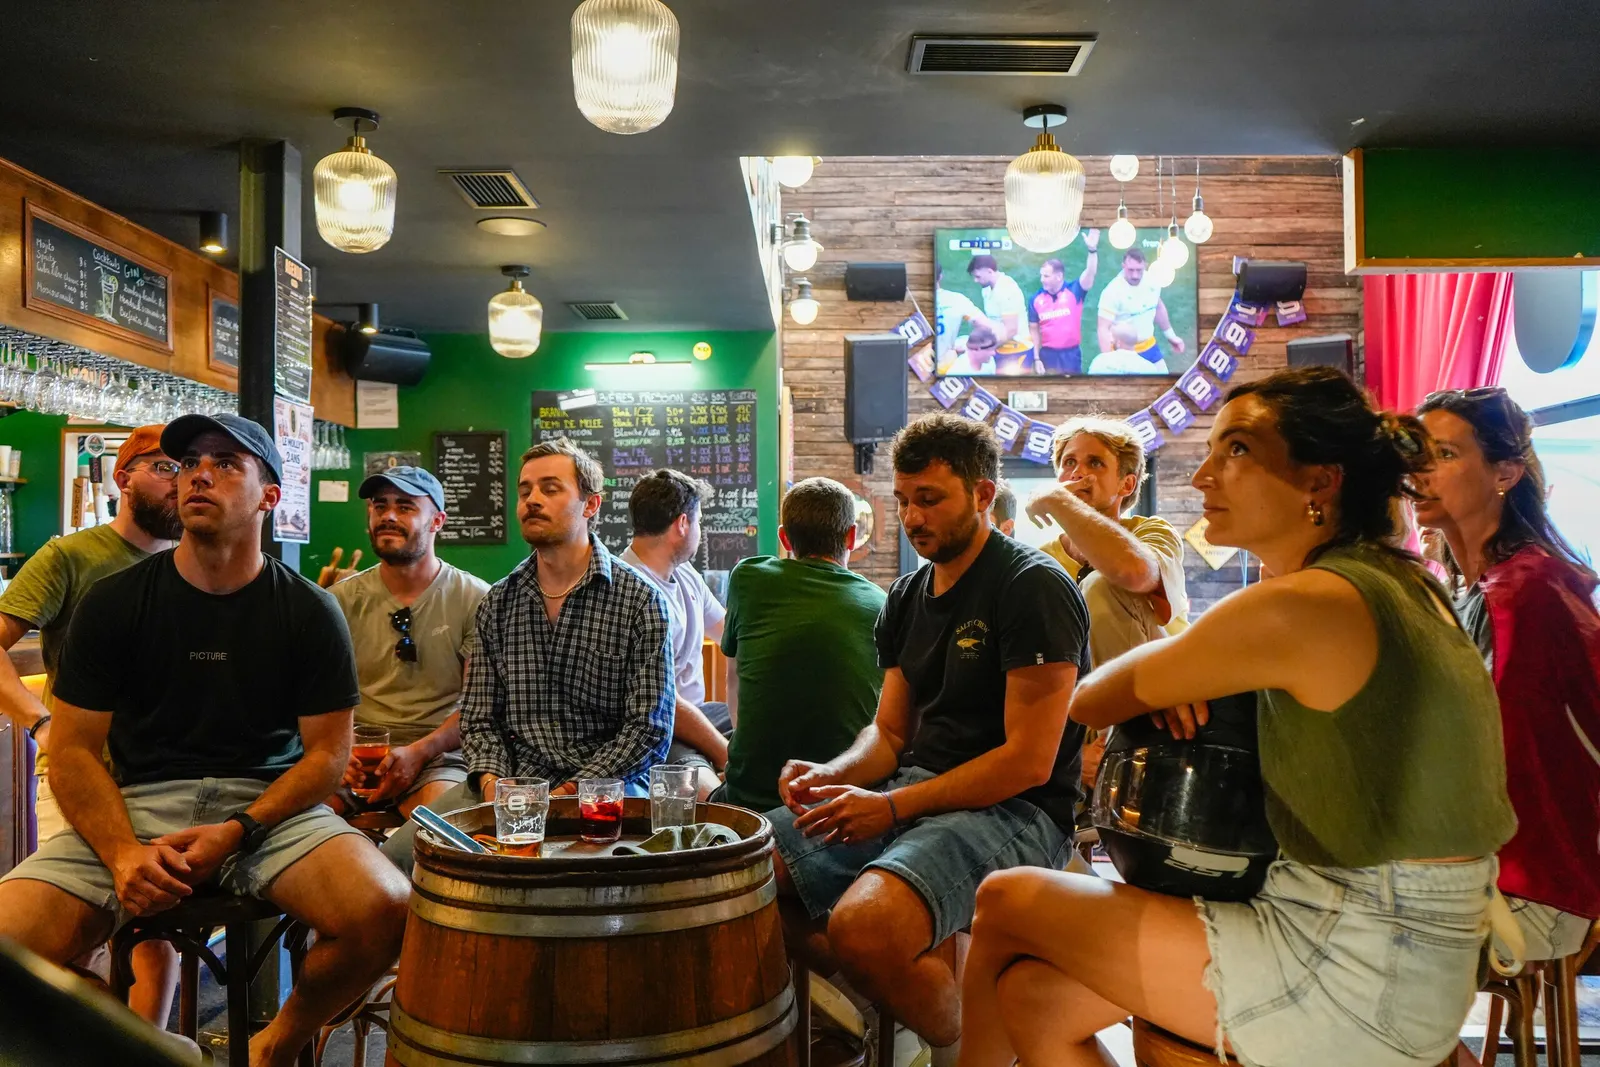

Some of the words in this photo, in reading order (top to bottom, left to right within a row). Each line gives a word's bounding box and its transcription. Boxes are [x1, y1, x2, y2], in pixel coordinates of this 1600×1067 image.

[93, 248, 120, 270] Cocktails
[124, 264, 140, 278] GIN
[564, 419, 577, 429] DE
[286, 451, 290, 463] 2
[290, 453, 300, 465] ANS
[189, 651, 228, 661] PICTURE
